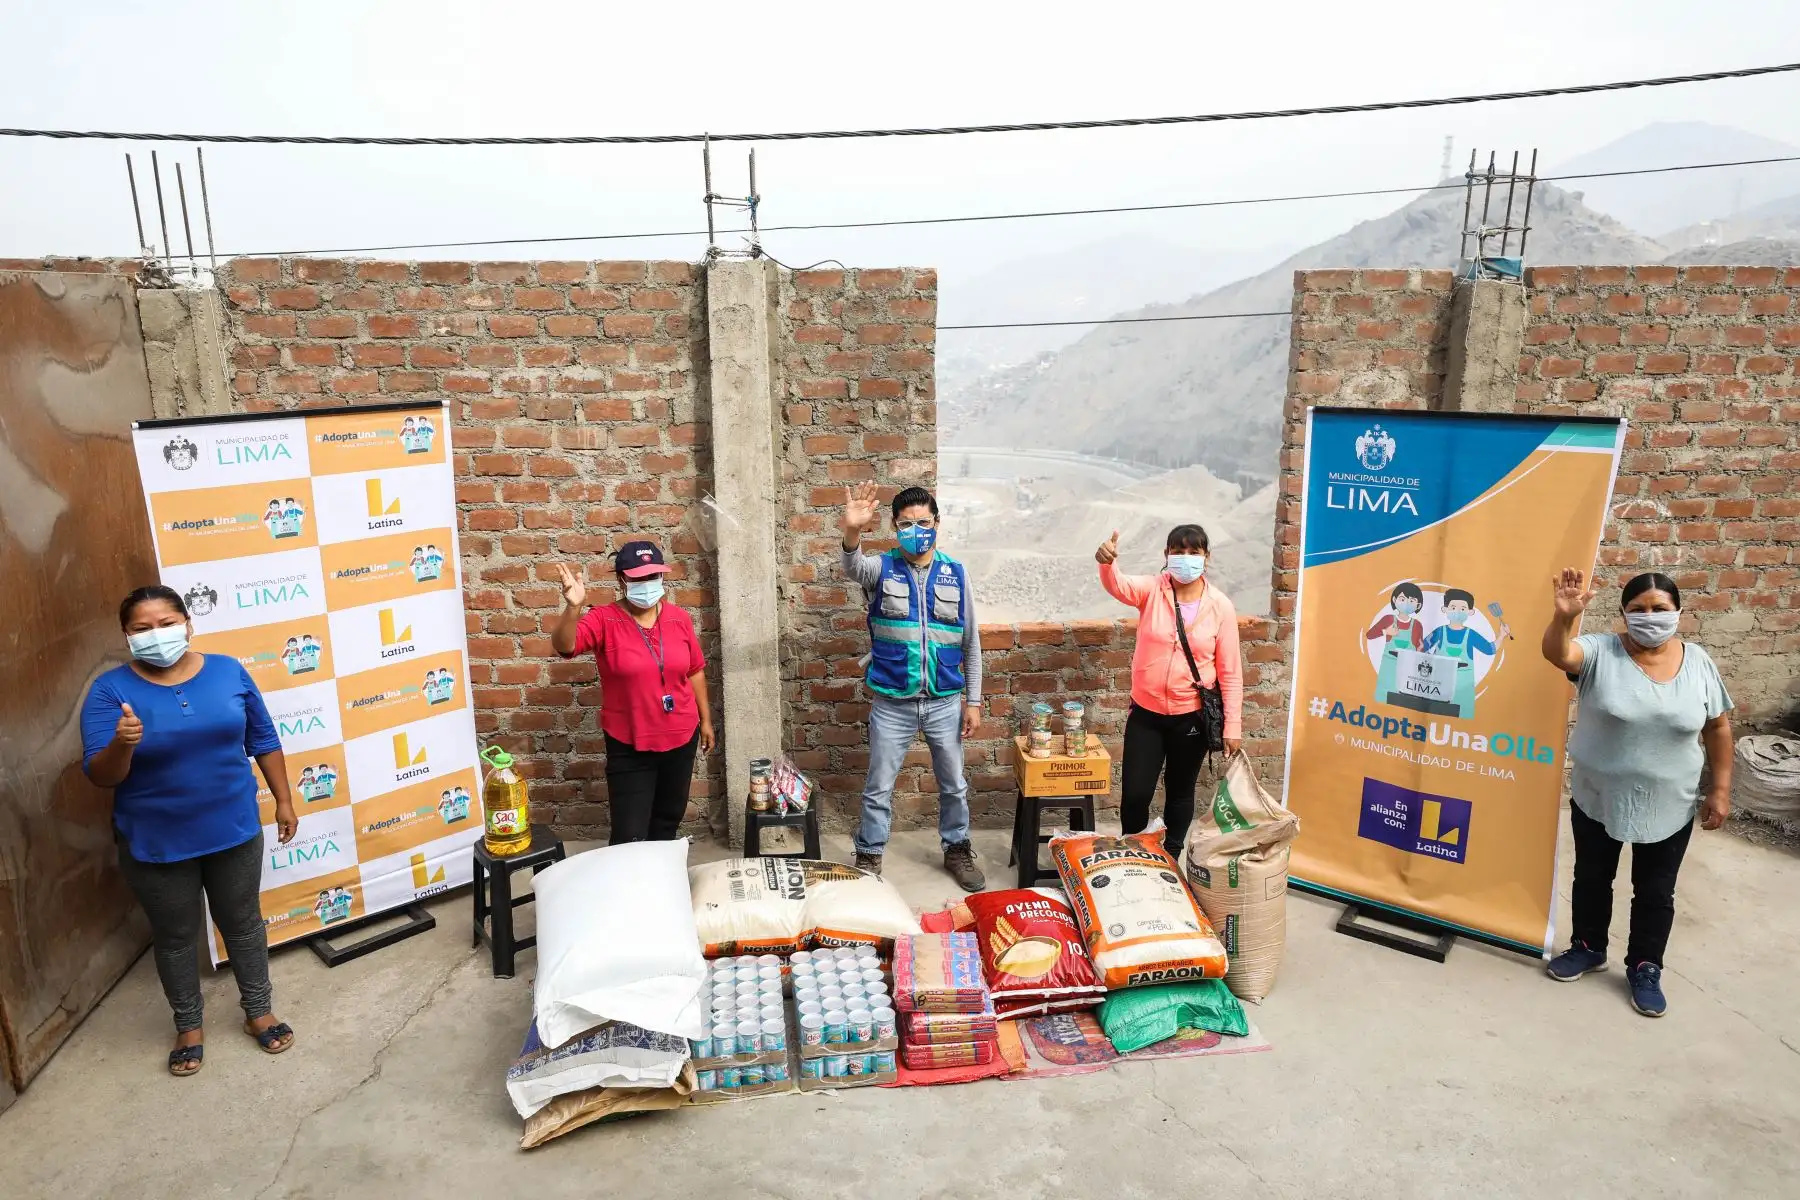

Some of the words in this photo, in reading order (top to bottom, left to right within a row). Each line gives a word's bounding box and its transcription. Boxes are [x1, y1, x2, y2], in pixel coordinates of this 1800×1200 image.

[216, 436, 278, 445] MUNICIPALIDAD
[217, 443, 292, 465] LIMA
[1328, 472, 1404, 486] MUNICIPALIDAD
[1406, 478, 1420, 486] DE
[1326, 486, 1419, 516] LIMA
[368, 518, 404, 530] Latina
[235, 576, 296, 590] MUNICIPALIDAD
[936, 577, 958, 585] LIMA
[236, 583, 310, 608] LIMA
[382, 644, 415, 658] Latina
[1406, 681, 1440, 696] LIMA
[280, 716, 326, 737] MA
[1308, 696, 1554, 764] #AdoptaUnaOlla
[1350, 736, 1451, 768] MUNICIPALIDAD
[1456, 760, 1475, 773] DE
[1480, 764, 1516, 782] LIMA
[396, 766, 430, 782] Latina
[1370, 803, 1407, 821] alianza
[1395, 800, 1408, 812] En
[1384, 817, 1406, 830] con:
[270, 833, 328, 854] MUNICIPALIDAD
[1416, 842, 1458, 858] Latina
[272, 840, 340, 870] LIMA
[1080, 850, 1168, 869] FARAON
[1230, 857, 1238, 880] AZÚCA
[414, 884, 448, 900] Latina
[1006, 900, 1050, 914] AVENA
[1075, 890, 1092, 929] FARAON
[743, 944, 796, 953] FARAON
[1067, 940, 1082, 956] 10
[1128, 966, 1204, 985] FARAON
